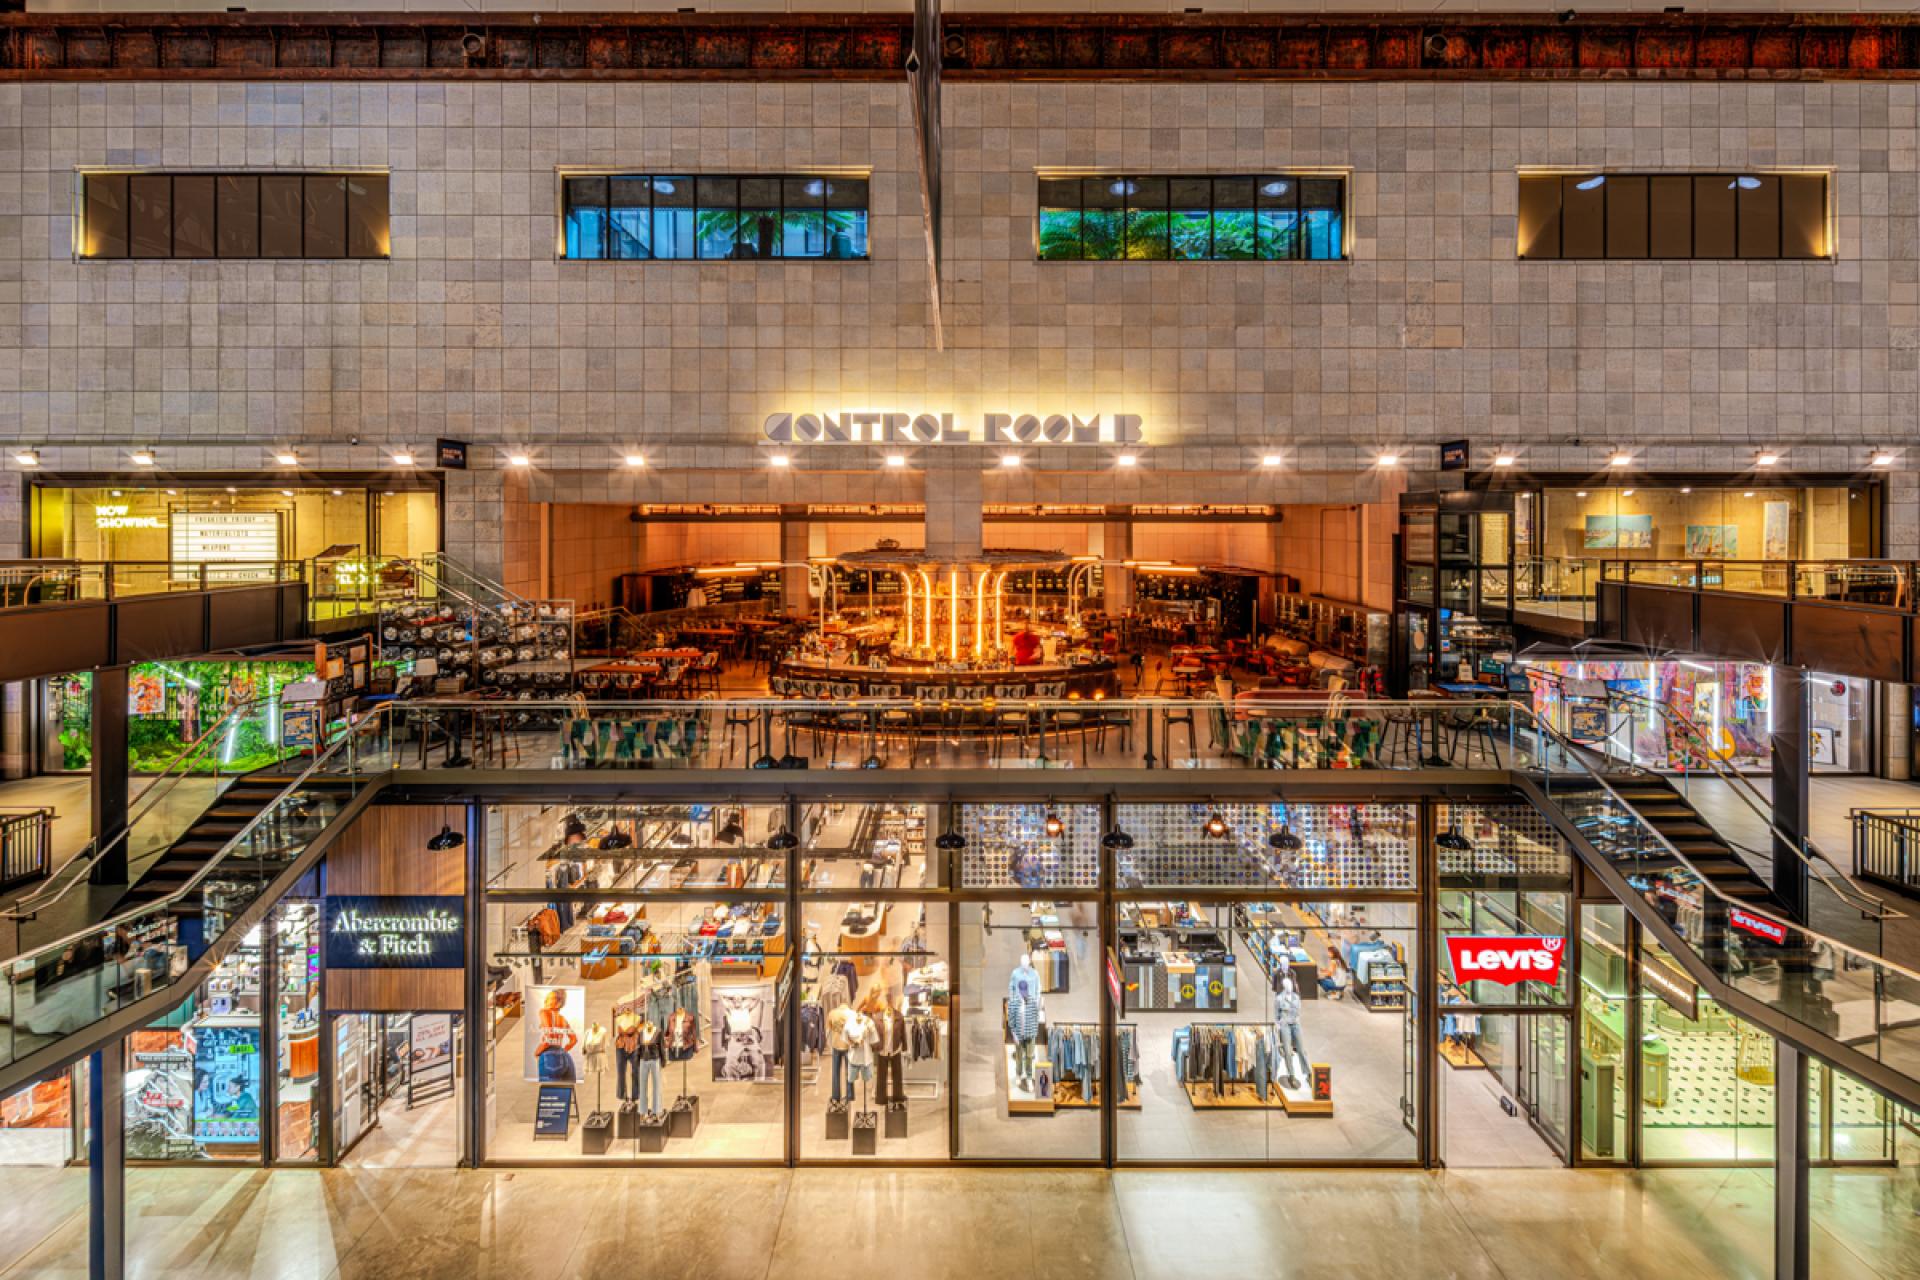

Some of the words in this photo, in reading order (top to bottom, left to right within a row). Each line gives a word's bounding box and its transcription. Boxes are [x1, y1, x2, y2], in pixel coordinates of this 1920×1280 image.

[764, 412, 970, 442] CONTROL
[984, 412, 1100, 442] ROOM
[1114, 413, 1143, 442] B
[95, 504, 129, 516] NOW
[331, 909, 460, 932] Abercrombie
[358, 938, 377, 954] &
[379, 933, 431, 955] Fitch
